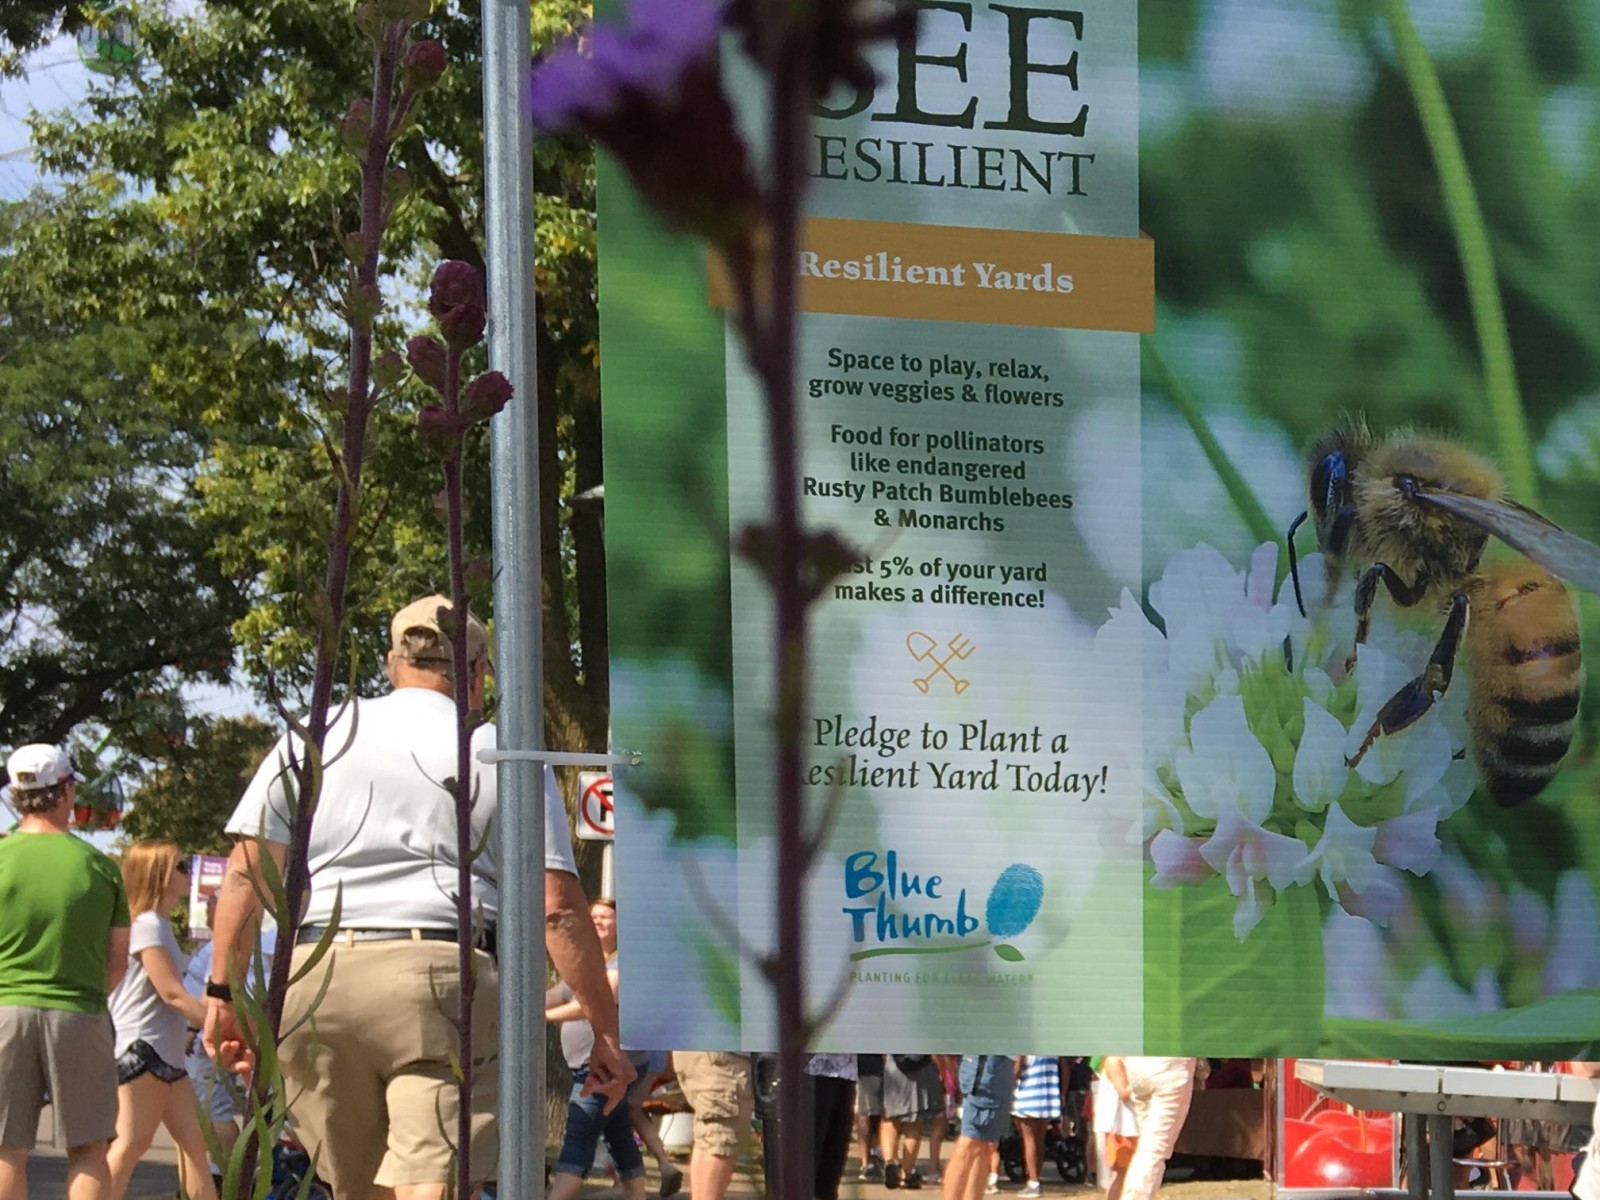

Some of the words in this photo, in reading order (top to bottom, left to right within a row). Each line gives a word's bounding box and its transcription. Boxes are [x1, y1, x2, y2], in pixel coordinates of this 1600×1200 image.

[808, 0, 1090, 138] EE
[806, 135, 1096, 197] ESILIENT
[799, 251, 966, 287] Resilient
[973, 262, 1074, 294] Yards
[827, 347, 895, 373] Space
[900, 353, 924, 373] to
[928, 354, 983, 381] play,
[988, 358, 1050, 383] relax,
[808, 378, 864, 398] grow
[868, 379, 955, 404] veggies
[961, 384, 979, 404] &
[984, 383, 1065, 408] flowers
[830, 424, 883, 446] Food
[889, 427, 920, 448] for
[926, 430, 1045, 455] pollinators
[850, 451, 891, 473] like
[896, 456, 1026, 482] endangered
[802, 476, 866, 504] Rusty
[871, 480, 933, 503] Patch
[939, 484, 1074, 510] Bumblebees
[873, 508, 891, 527] &
[898, 509, 1005, 533] Monarchs
[879, 556, 914, 579] 5%
[919, 558, 943, 577] of
[946, 562, 996, 583] your
[1000, 562, 1048, 585] yard
[834, 582, 906, 603] makes
[911, 587, 924, 603] a
[930, 584, 1046, 608] difference!
[812, 713, 911, 758] Pledge
[920, 721, 949, 751] to
[958, 718, 1043, 754] Plant
[1050, 732, 1070, 754] a
[802, 754, 921, 789] esilient
[927, 759, 1000, 792] Yard
[1005, 760, 1109, 802] Today!
[844, 849, 943, 901] Blue
[841, 887, 980, 943] Thumb
[850, 970, 911, 984] PLANTING
[915, 972, 939, 984] FOR
